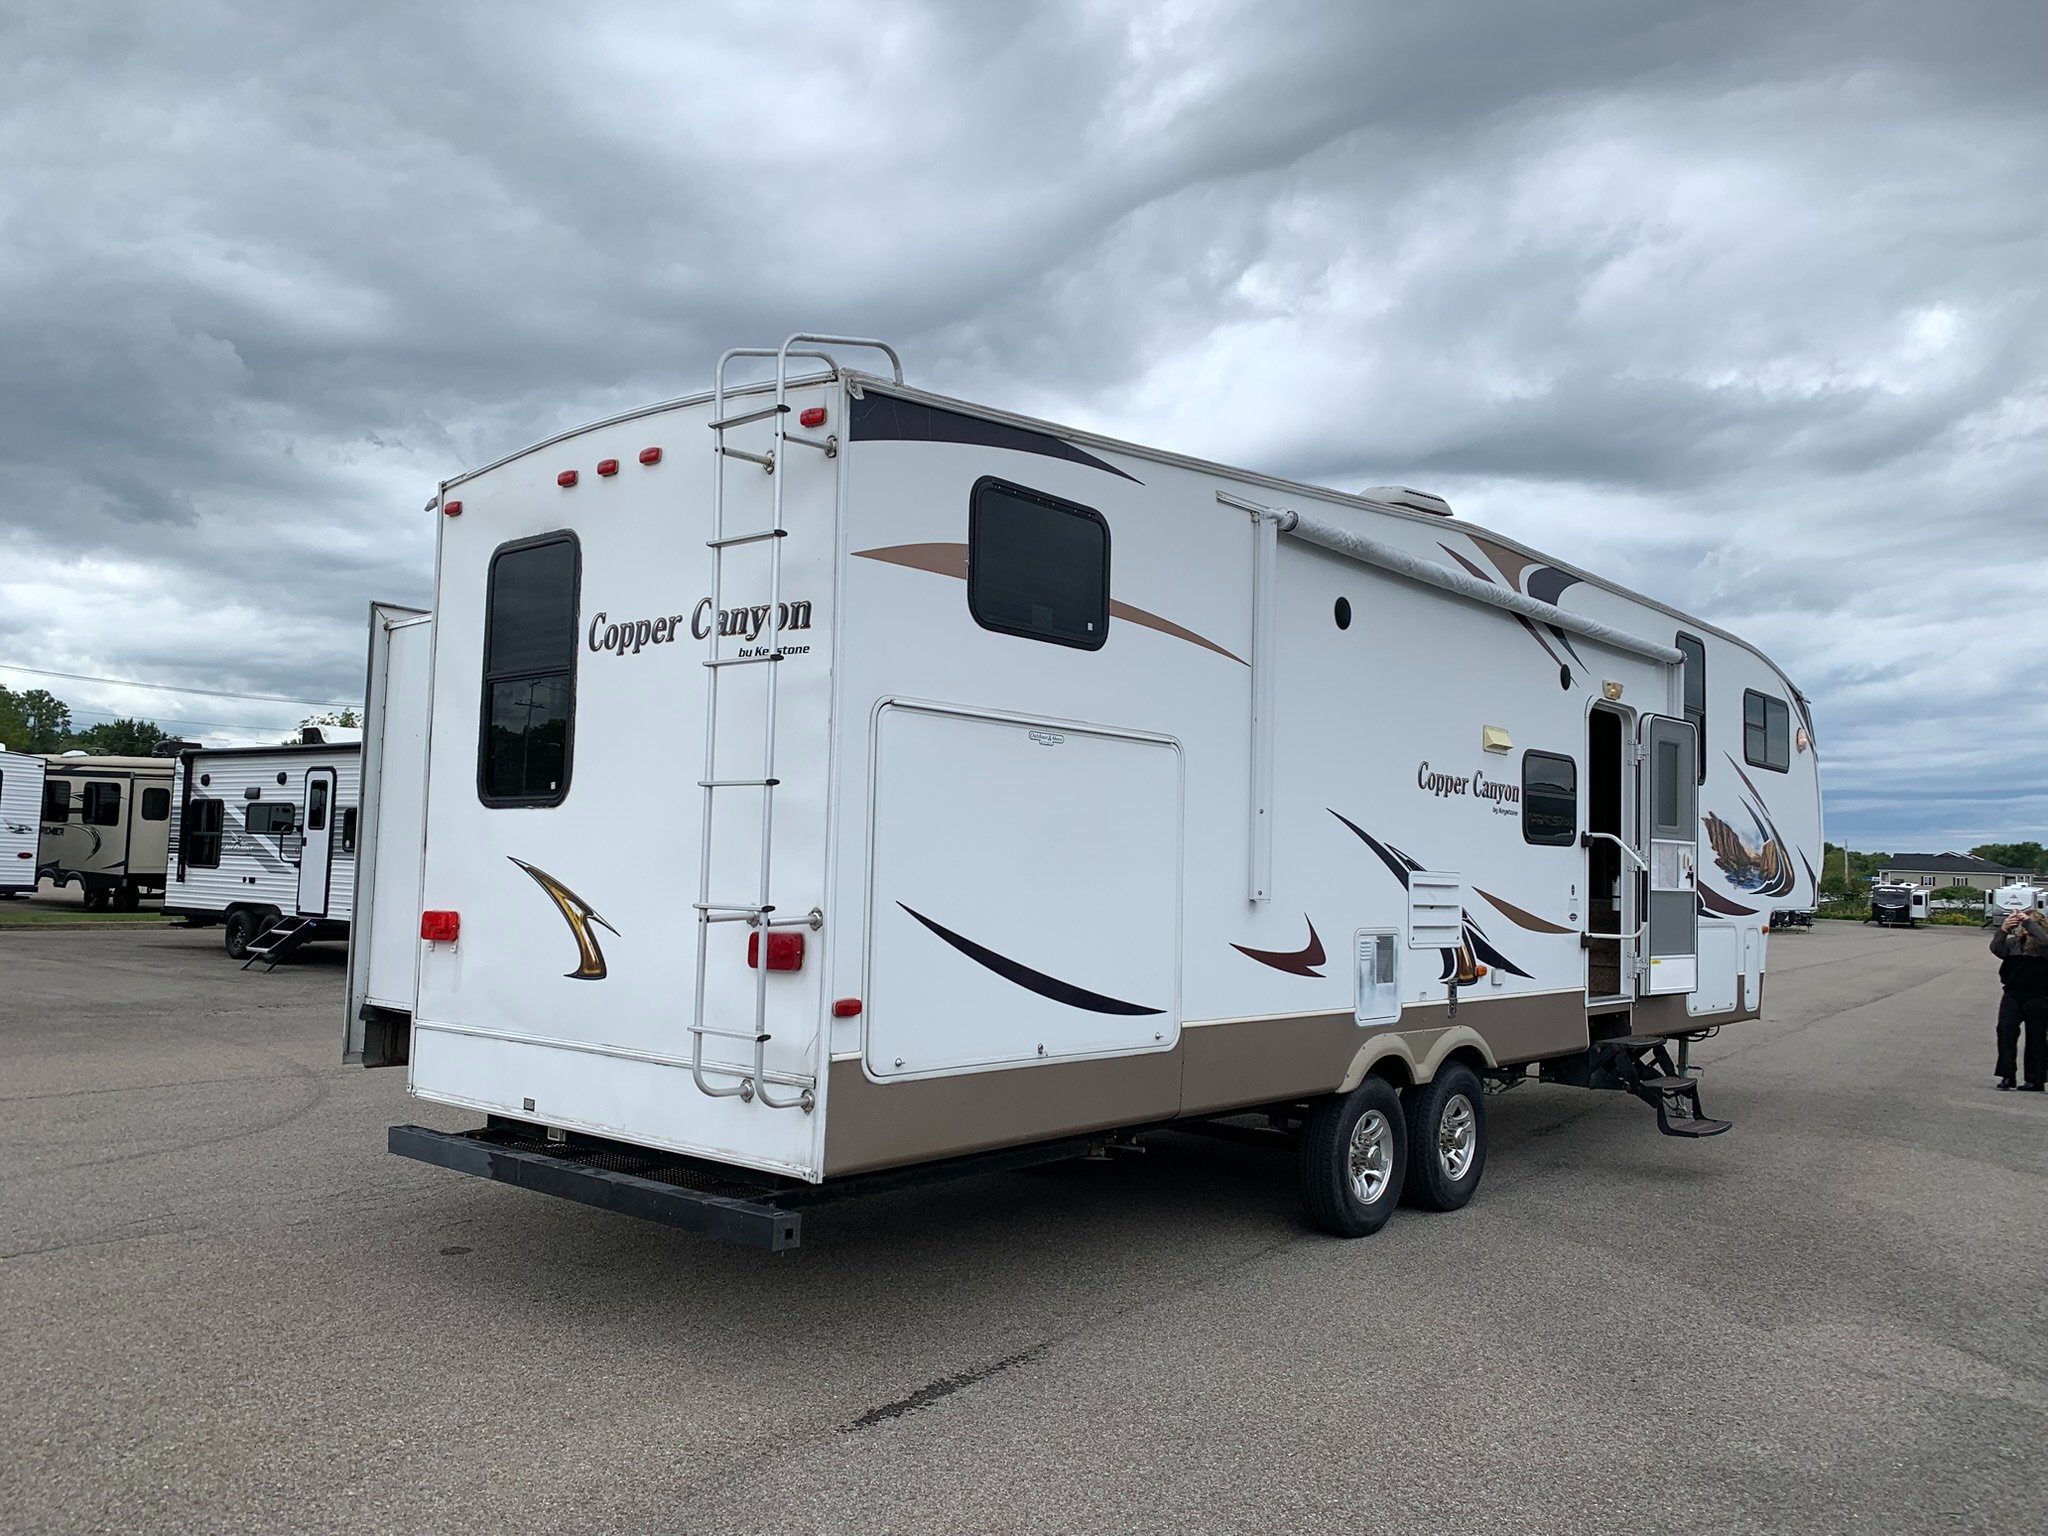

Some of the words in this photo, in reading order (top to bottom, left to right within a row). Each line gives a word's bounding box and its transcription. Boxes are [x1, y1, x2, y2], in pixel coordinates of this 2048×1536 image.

[589, 612, 682, 656] Copper
[691, 597, 812, 642] Canyon
[754, 645, 811, 657] Kestone
[1418, 761, 1469, 798] Copper
[1473, 770, 1520, 804] Canyon
[1492, 806, 1499, 815] by
[1499, 807, 1518, 816] Keystone
